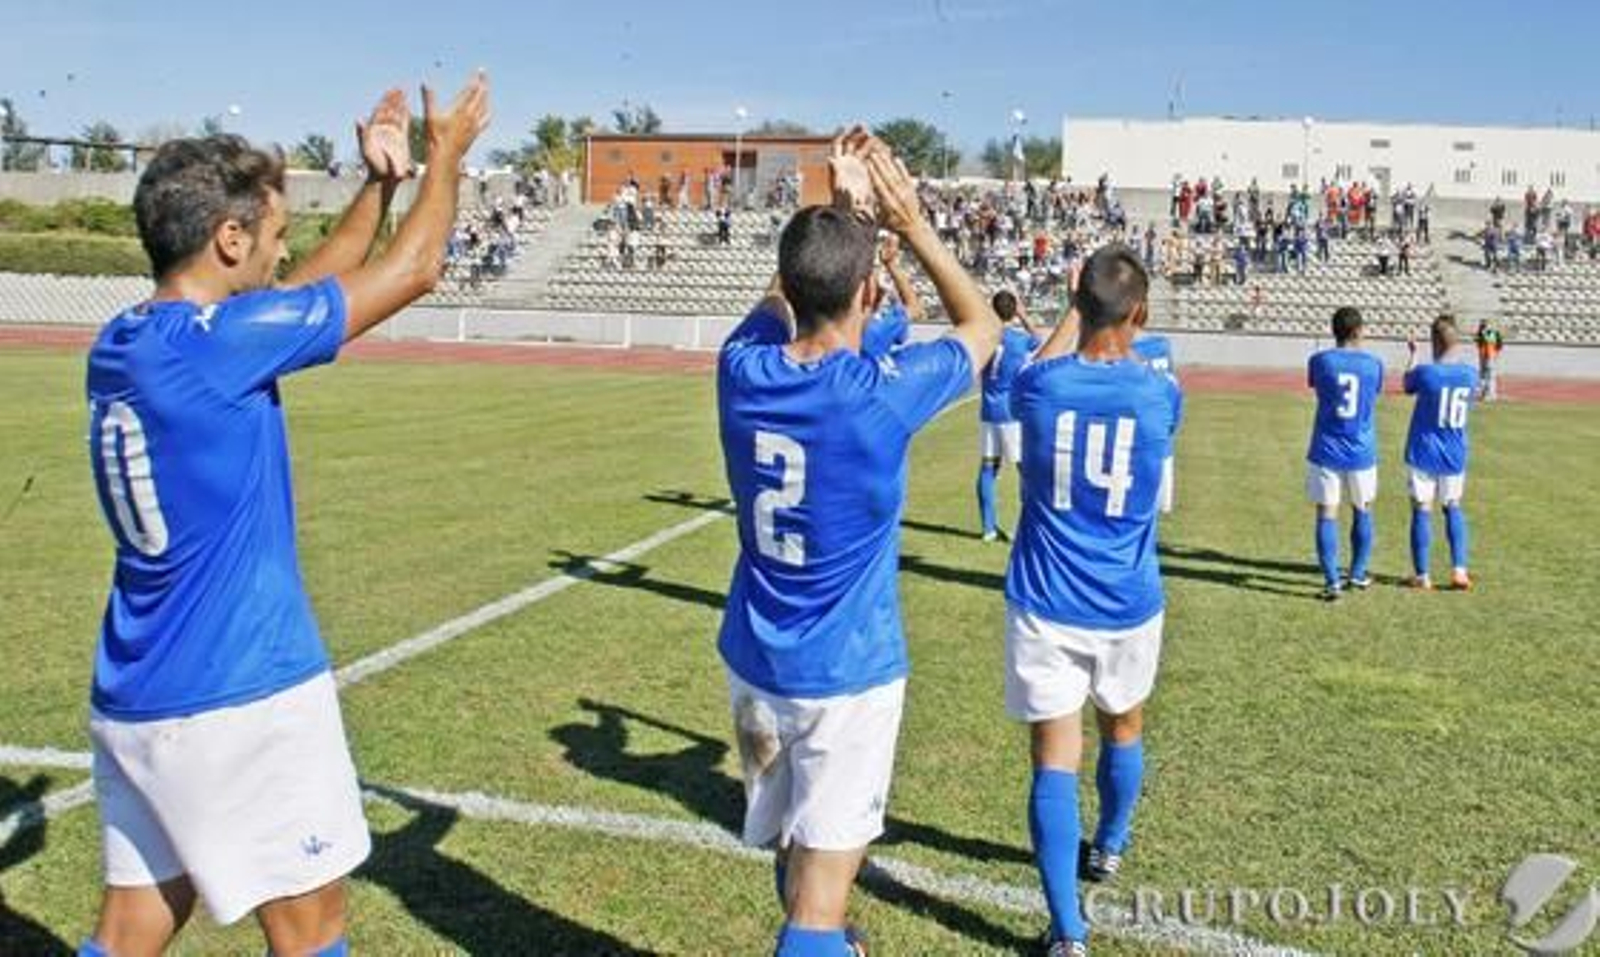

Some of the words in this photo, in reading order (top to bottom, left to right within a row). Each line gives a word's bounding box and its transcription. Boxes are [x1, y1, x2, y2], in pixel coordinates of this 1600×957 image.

[1336, 373, 1360, 419] 3
[1438, 386, 1470, 429] 16
[753, 430, 806, 566] 2
[1053, 410, 1137, 517] 14
